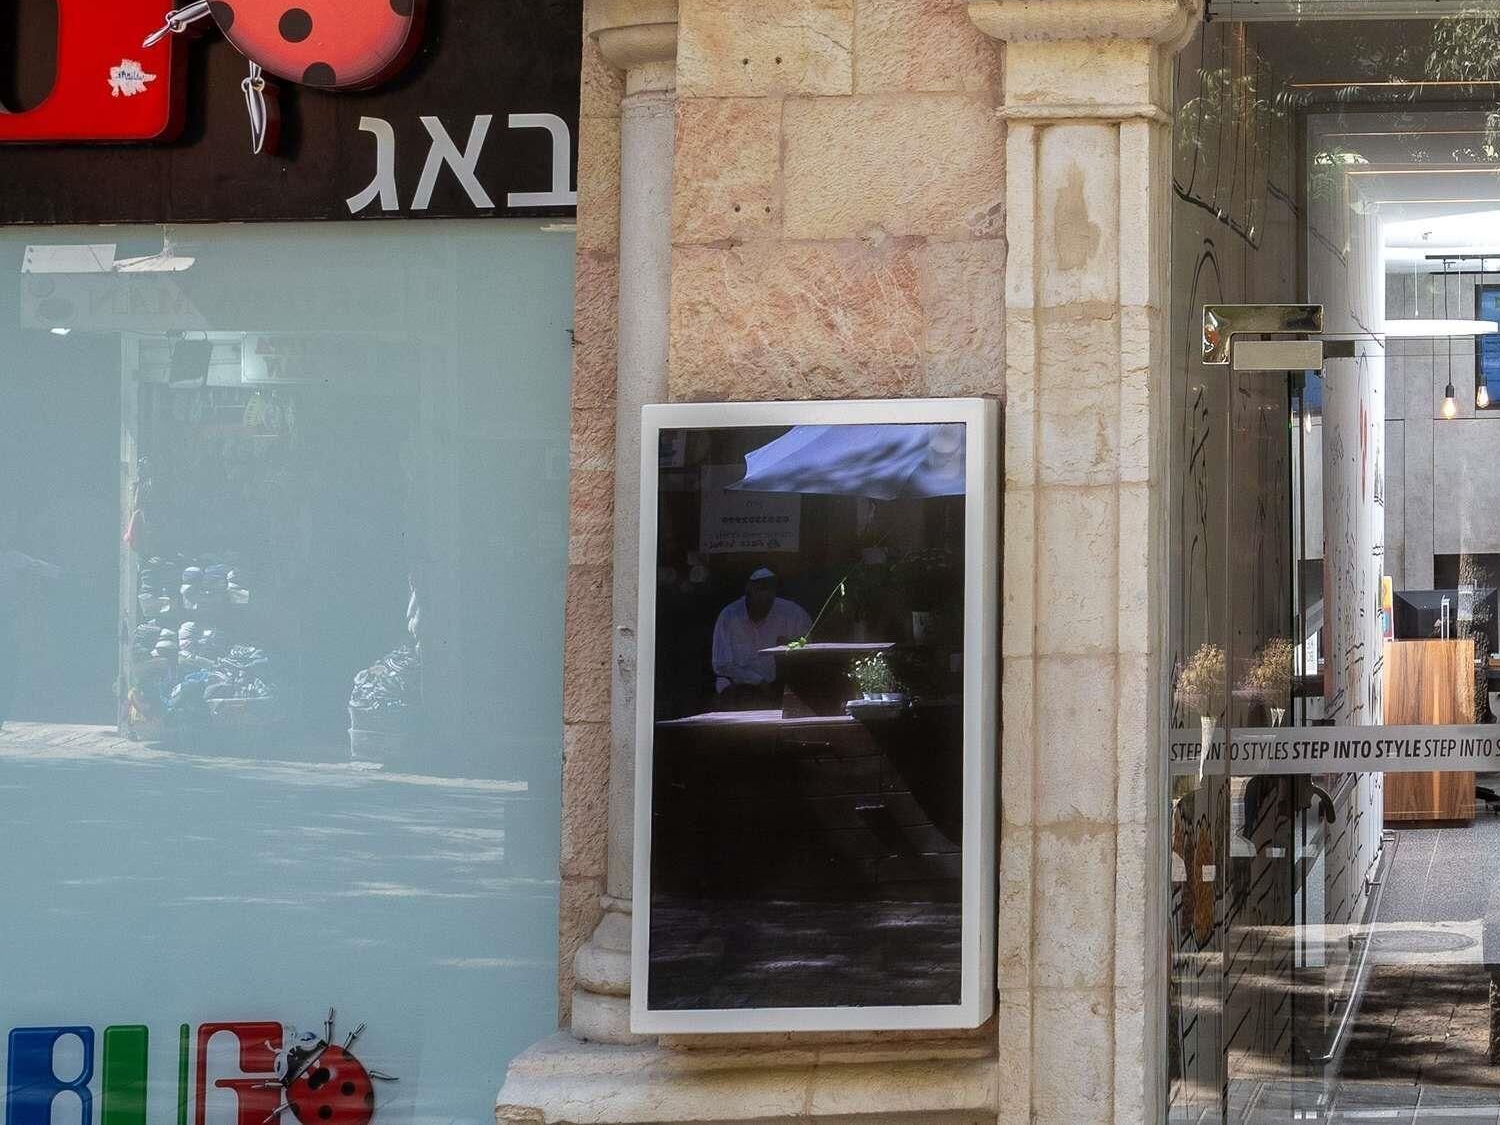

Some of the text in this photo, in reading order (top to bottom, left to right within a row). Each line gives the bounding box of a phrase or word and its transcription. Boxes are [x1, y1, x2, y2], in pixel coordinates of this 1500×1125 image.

[346, 113, 578, 214] באג
[1170, 742, 1201, 761] STEP
[1242, 741, 1289, 761] STYLES
[1292, 740, 1330, 759] STEP
[1333, 739, 1372, 759] INTO
[1375, 738, 1421, 758] STYLE
[1424, 738, 1457, 757] STEP
[1459, 738, 1492, 757] INTO
[7, 1021, 284, 1125] BUG
